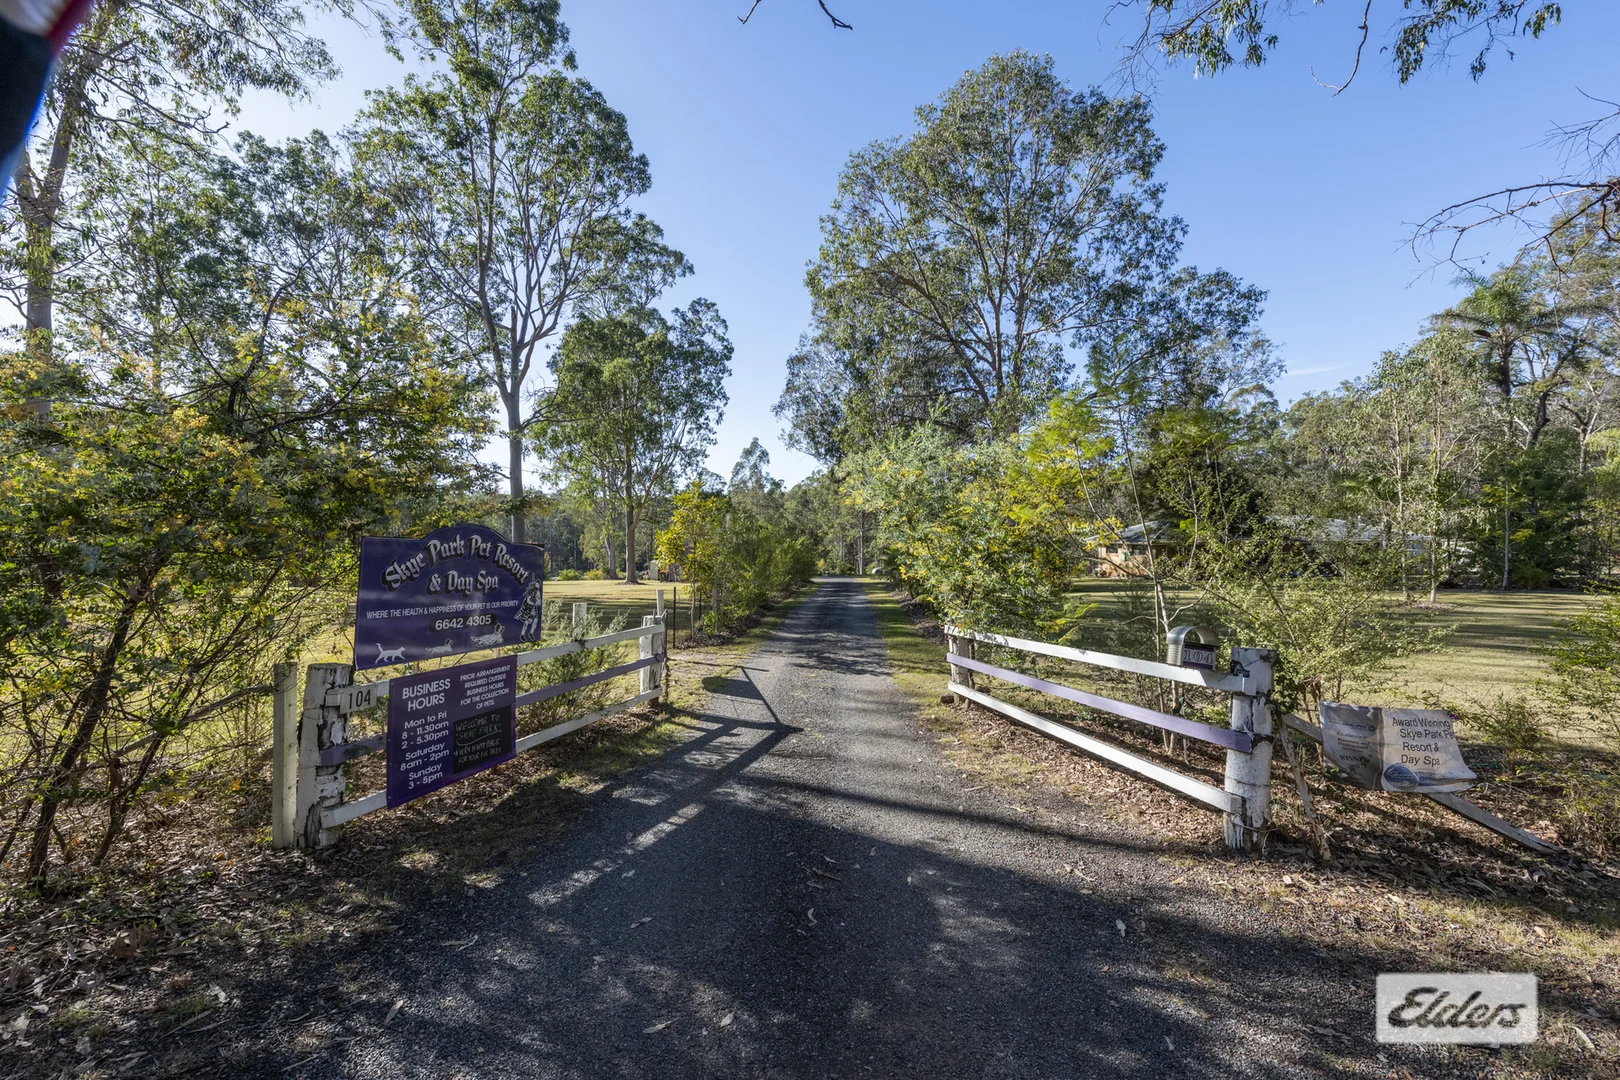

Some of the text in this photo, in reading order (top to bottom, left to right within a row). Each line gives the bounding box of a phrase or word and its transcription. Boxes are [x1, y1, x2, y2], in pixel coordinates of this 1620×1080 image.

[385, 534, 529, 589] Skye Park Pet Resort
[429, 570, 499, 595] & Day Spa
[366, 609, 389, 619] WHERE
[390, 608, 401, 617] THE
[402, 606, 423, 616] HEALTH
[428, 605, 457, 614] HAPPINESS
[464, 603, 477, 611] YOUR
[477, 602, 486, 610] PET
[491, 601, 500, 609] OUR
[500, 600, 518, 608] PRIORITY
[435, 615, 492, 630] 6642 4305
[1184, 649, 1214, 664] 104
[460, 665, 511, 682] PRIOR ARRANGEMENT
[464, 673, 507, 688] REQUIRED OUTSIDE
[402, 678, 451, 700] BUSINESS
[460, 688, 510, 706] FOR THE COLLECTION
[466, 681, 504, 696] BUSINESS HOURS
[349, 689, 371, 709] 104
[407, 692, 445, 712] HOURS
[476, 702, 484, 710] OF
[404, 711, 447, 730] Mon to Fri
[455, 714, 500, 731] WELCOME TO
[1392, 717, 1450, 730] Award Winning
[401, 731, 408, 740] 8
[416, 721, 449, 736] 11.30am
[401, 741, 408, 749] 2
[416, 729, 449, 745] 5.30pm
[1399, 728, 1422, 741] Skye
[1424, 729, 1443, 739] Park
[405, 742, 446, 760] Saturday
[1402, 741, 1439, 752] Resort &
[400, 758, 422, 772] 8am
[429, 750, 450, 763] 2pm
[1339, 754, 1370, 764] WINNER
[1401, 754, 1441, 767] Day Spa
[408, 763, 442, 781] Sunday
[408, 781, 414, 790] 3
[422, 771, 443, 785] 5pm
